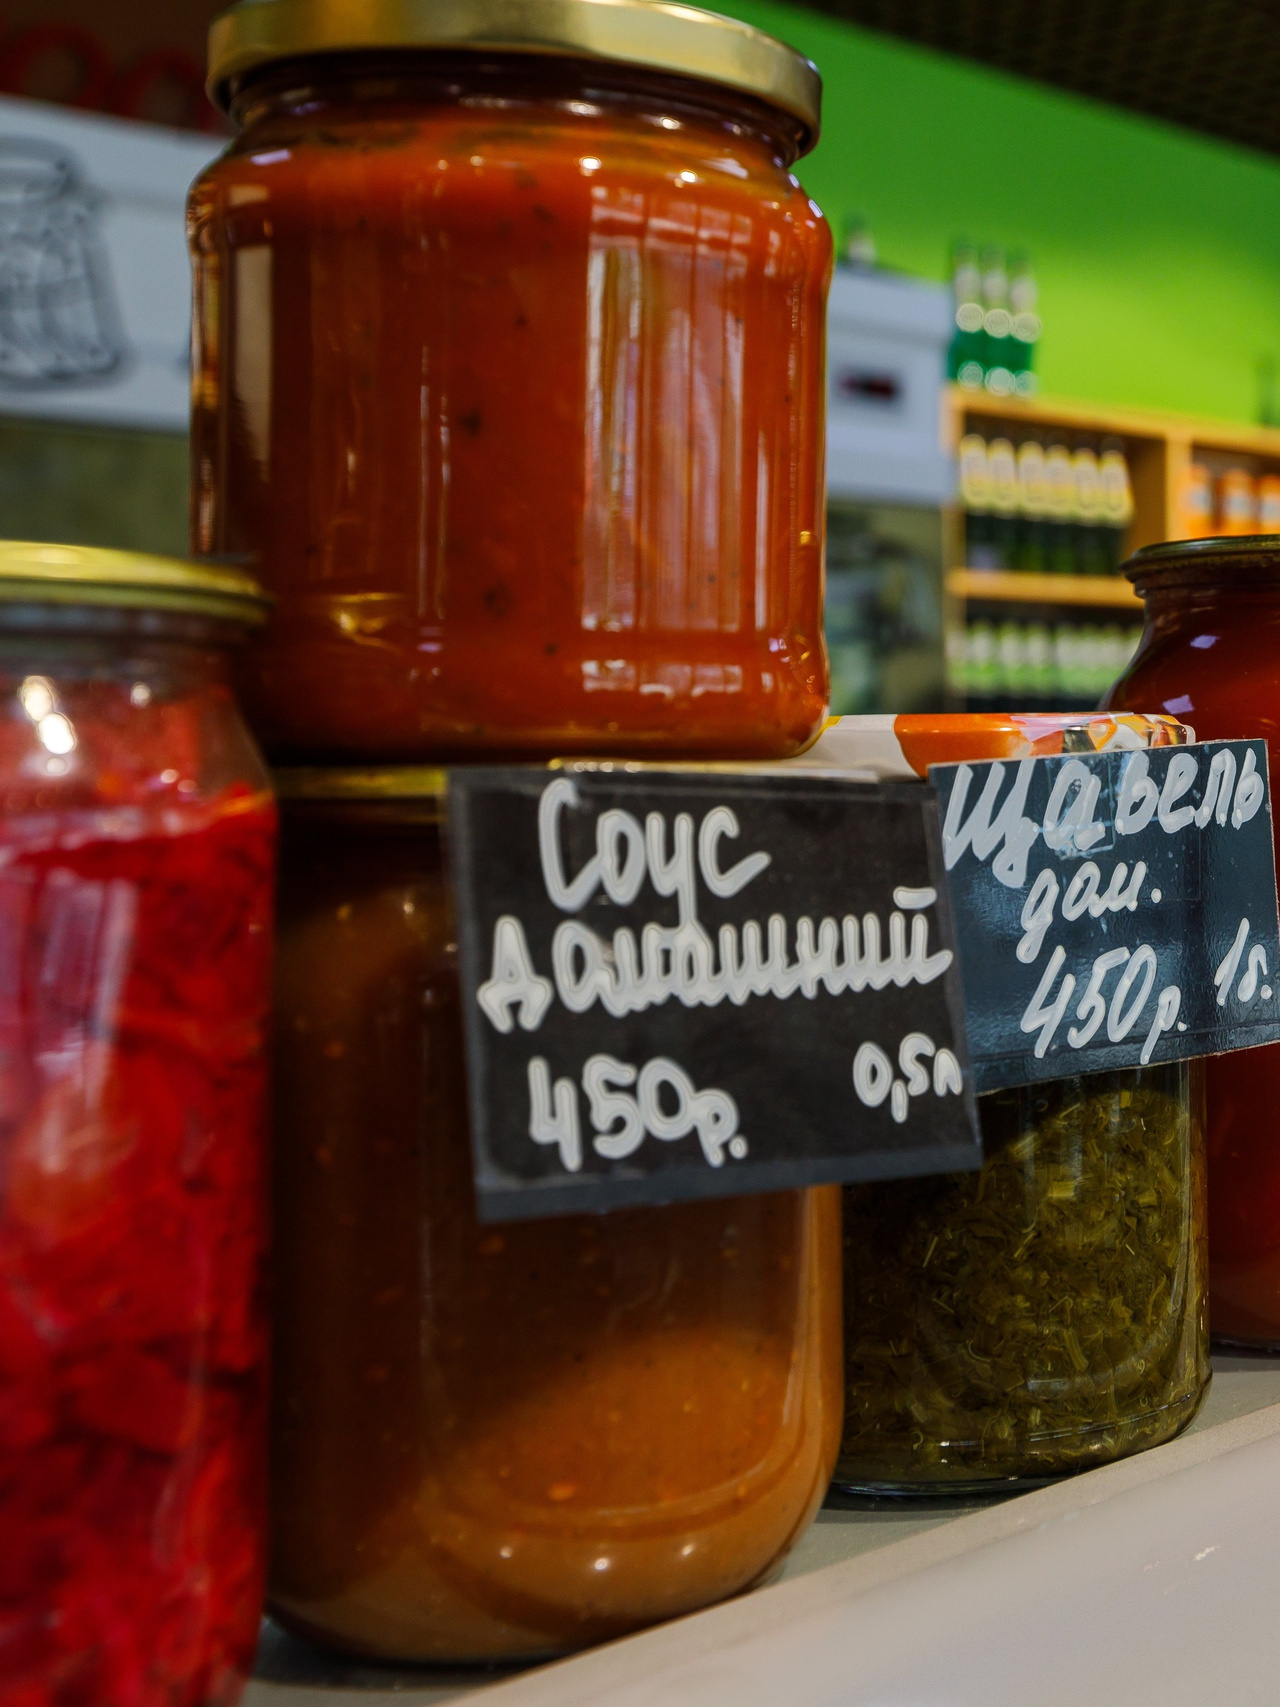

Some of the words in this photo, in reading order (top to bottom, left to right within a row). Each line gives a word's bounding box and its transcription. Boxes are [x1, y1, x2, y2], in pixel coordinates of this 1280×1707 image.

[538, 777, 771, 928] Соус
[943, 748, 1264, 888] Щавель
[1016, 861, 1162, 963] дом.
[1020, 944, 1187, 1065] 450р.
[528, 1053, 748, 1171] 450р.
[853, 1032, 963, 1124] 0,5л
